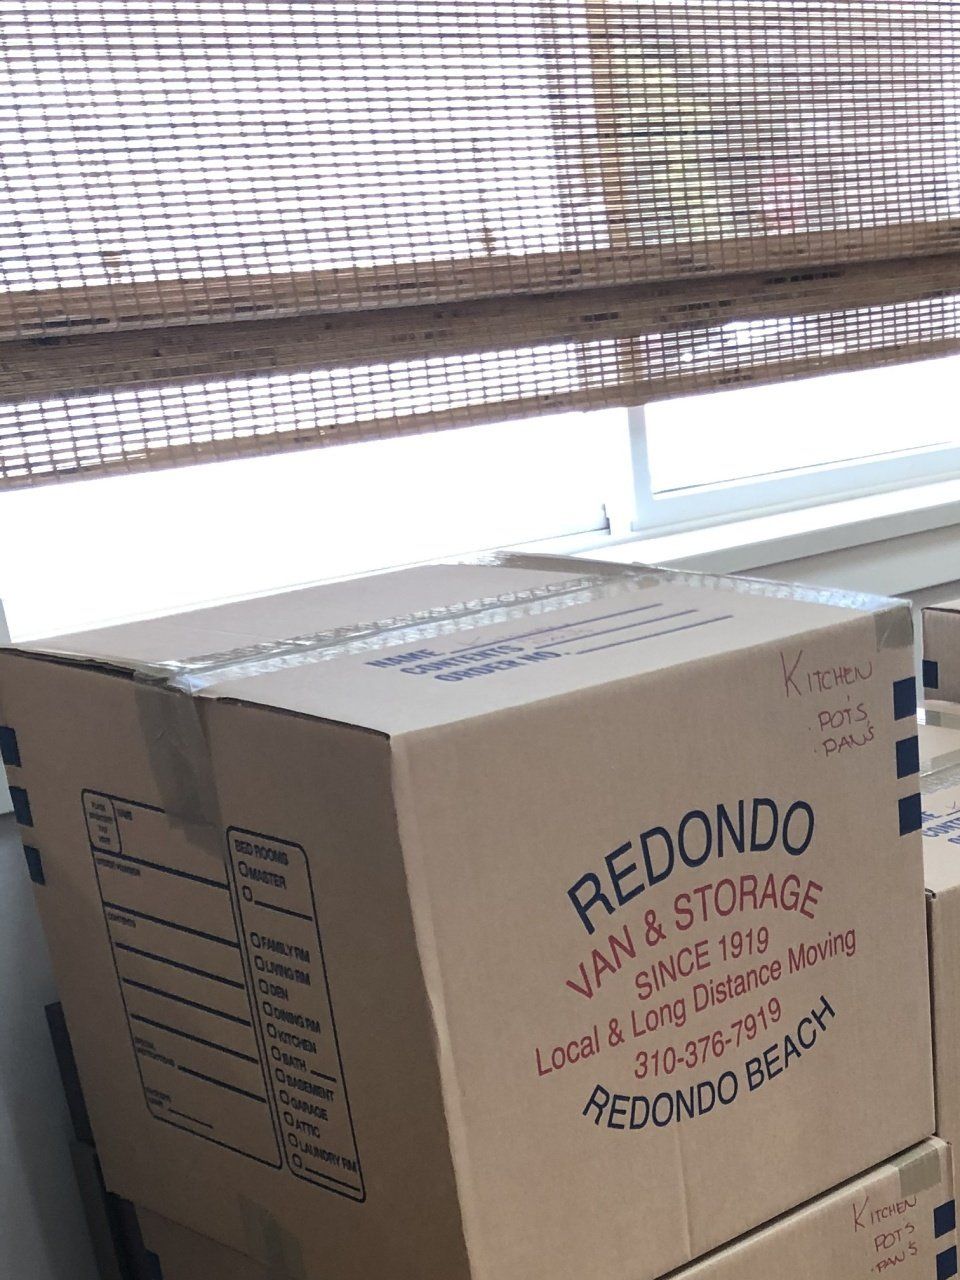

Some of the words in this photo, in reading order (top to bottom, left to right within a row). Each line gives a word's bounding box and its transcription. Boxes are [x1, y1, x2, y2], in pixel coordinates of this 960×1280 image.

[365, 650, 440, 668] NAME
[400, 646, 524, 675] CONTENTS
[435, 660, 525, 682] ORDER
[779, 650, 872, 698] KITCHEN
[567, 798, 814, 935] REDONDO
[566, 925, 635, 998] VAN
[645, 910, 666, 946] &
[675, 874, 823, 930] STORAGE
[636, 940, 710, 1000] SINCE
[719, 927, 768, 960] 1919
[536, 1026, 599, 1076] Local
[609, 1019, 625, 1047] &
[632, 999, 686, 1037] Long
[694, 961, 781, 1012] Distance
[789, 929, 855, 973] Moving
[635, 998, 780, 1079] 310-376-7919
[583, 1071, 738, 1129] REDONDO
[746, 995, 835, 1091] BEACH
[852, 1196, 917, 1233] KITCHEN
